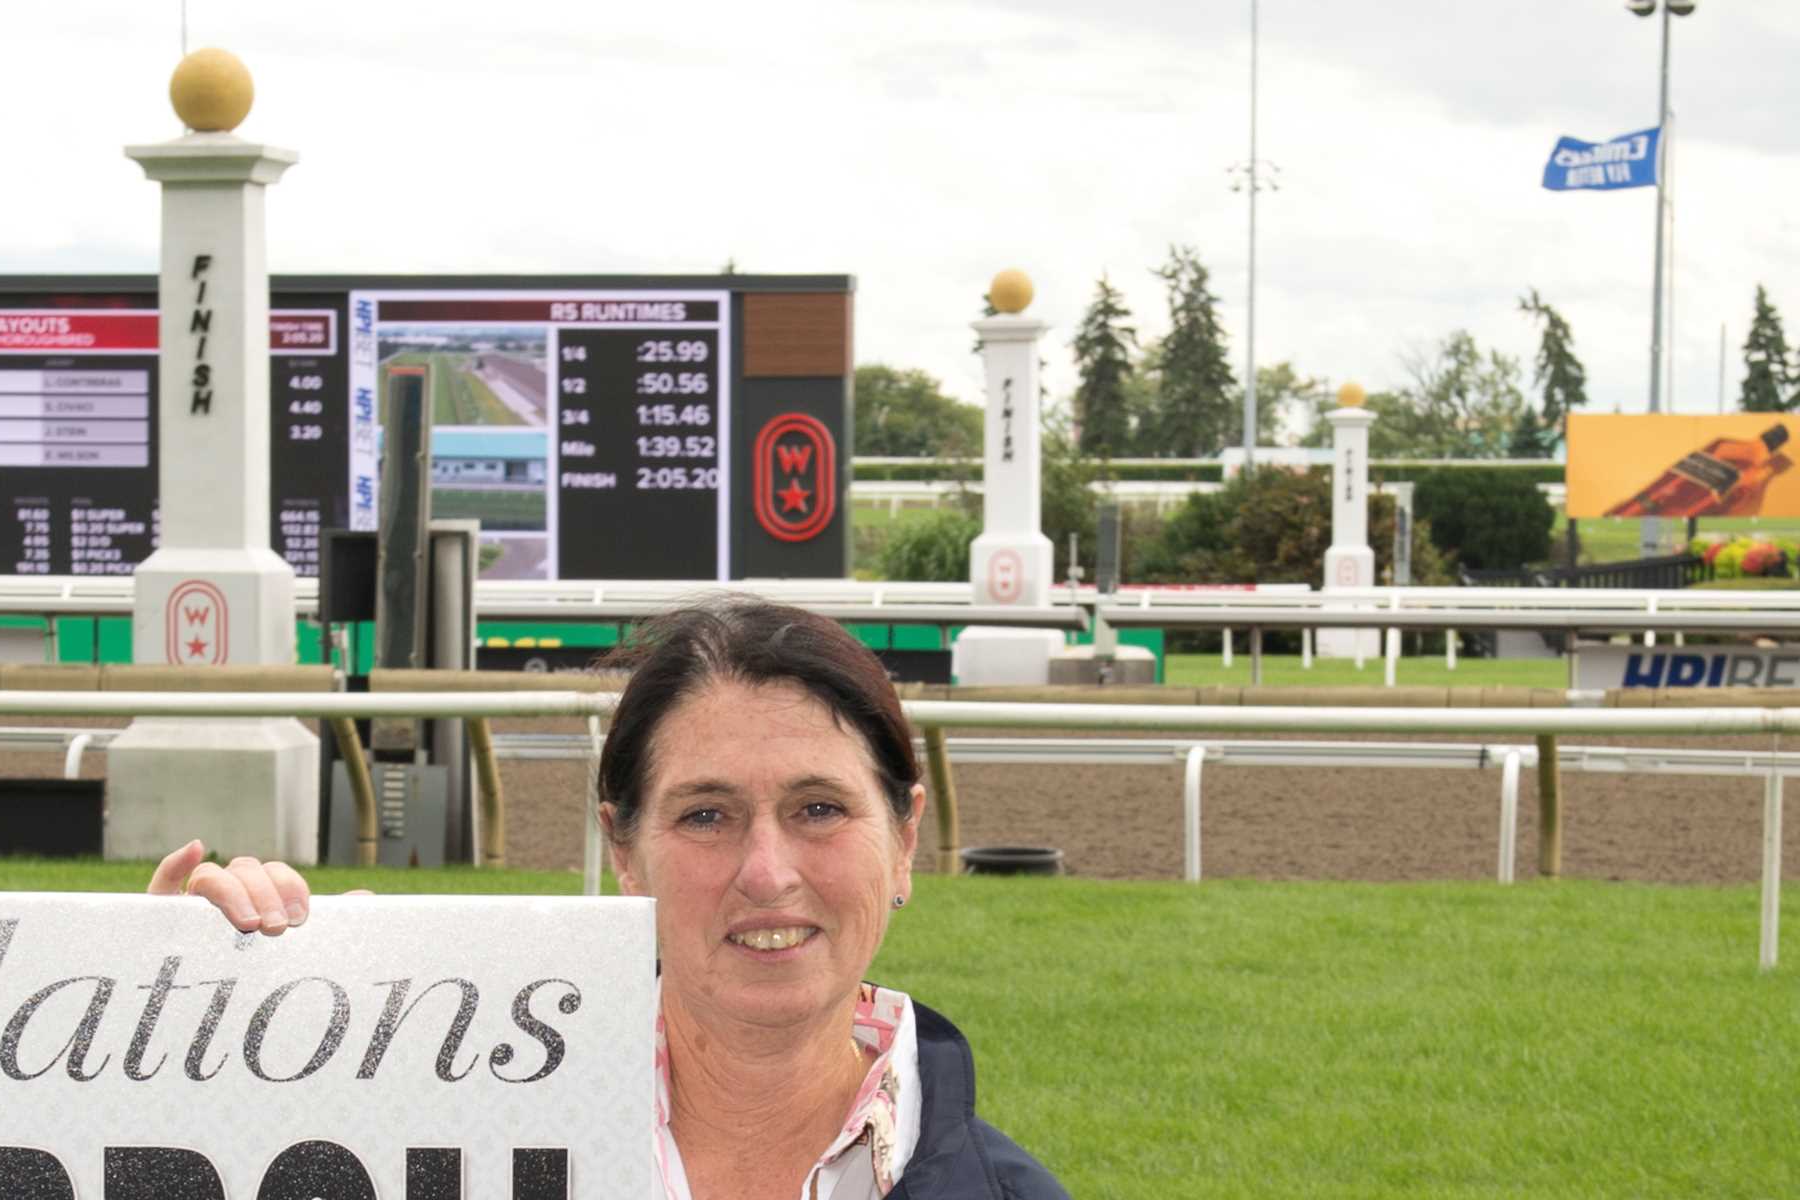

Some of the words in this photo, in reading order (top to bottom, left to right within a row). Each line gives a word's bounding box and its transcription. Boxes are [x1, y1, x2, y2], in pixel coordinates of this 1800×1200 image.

[550, 303, 578, 321] R5
[581, 303, 686, 321] RUNTIMES
[190, 255, 214, 416] FINISH
[637, 341, 708, 362] :25.99
[637, 372, 708, 394] :50.56
[561, 409, 589, 425] 3/4
[637, 404, 710, 426] 1:15.46
[561, 441, 596, 457] Mile
[637, 436, 715, 457] 1:39.52
[776, 445, 812, 475] W
[561, 472, 617, 488] FINISH
[636, 468, 719, 489] 2:05.20
[184, 606, 209, 627] W
[1622, 653, 1800, 687] HPIBE
